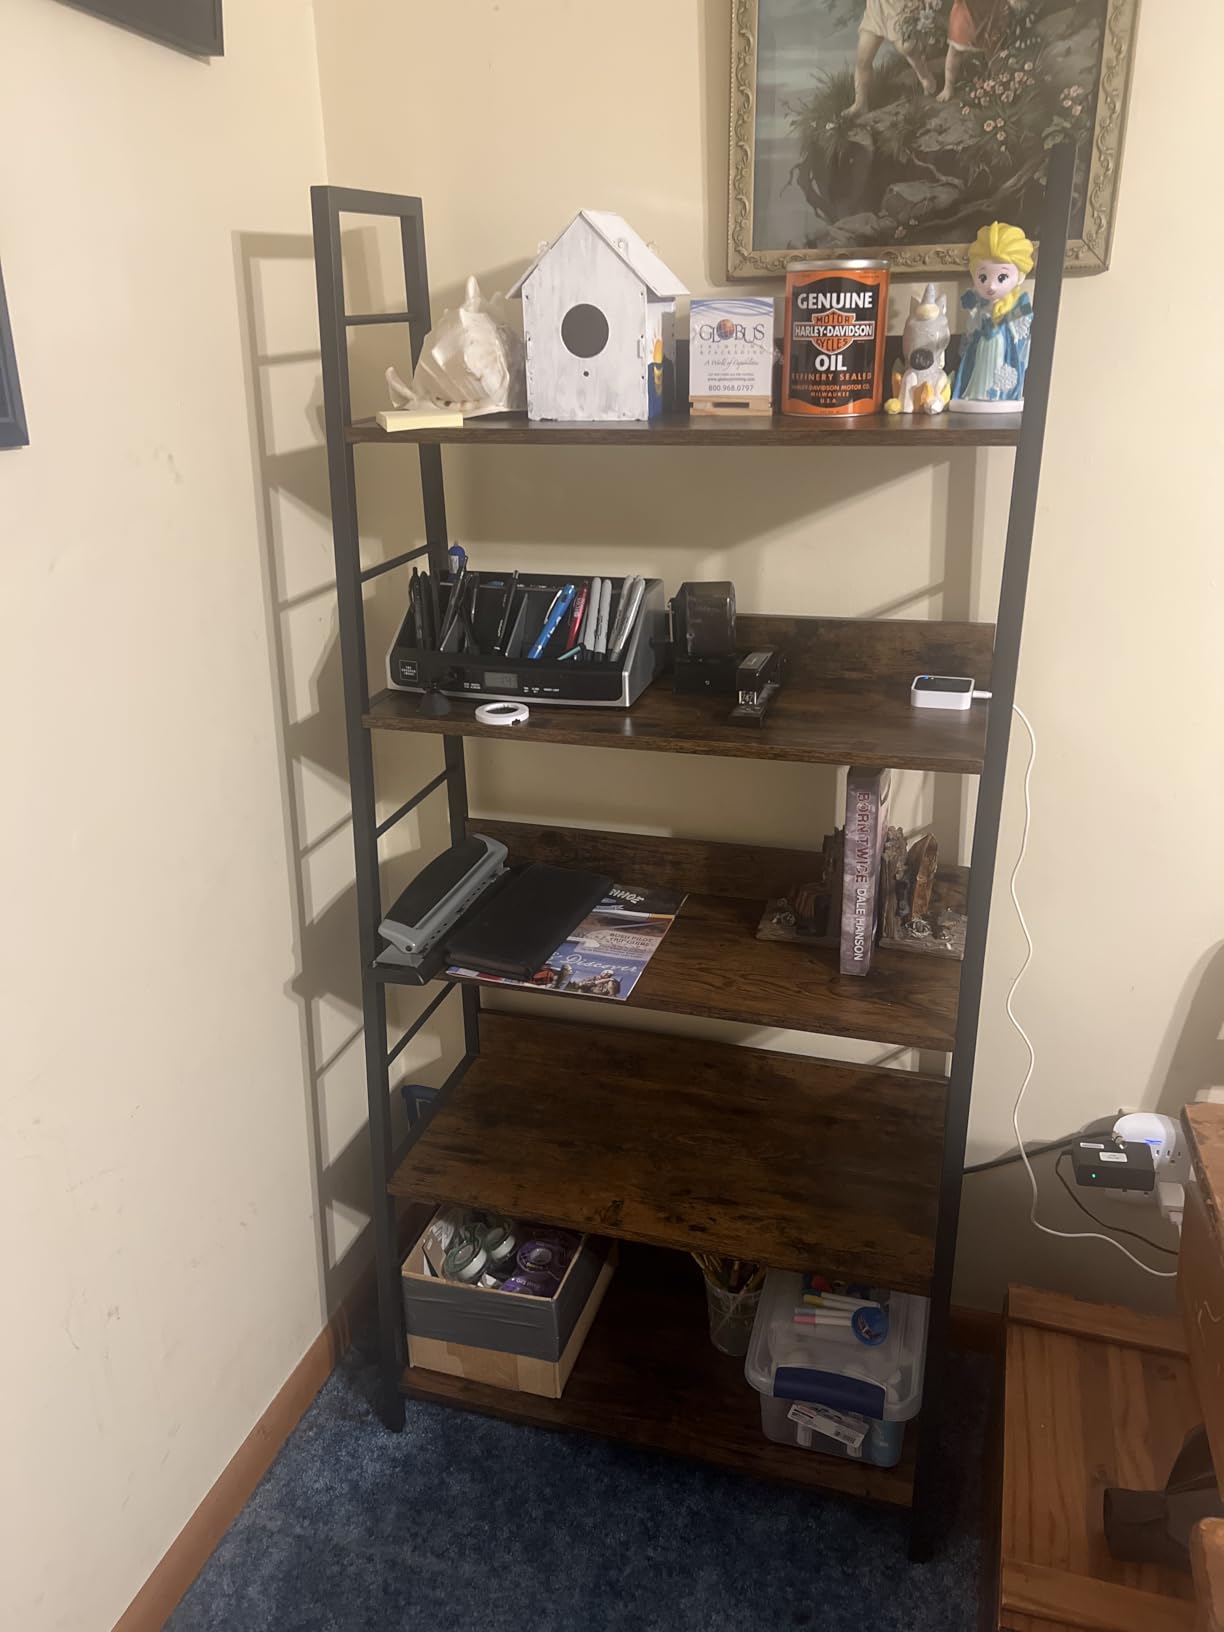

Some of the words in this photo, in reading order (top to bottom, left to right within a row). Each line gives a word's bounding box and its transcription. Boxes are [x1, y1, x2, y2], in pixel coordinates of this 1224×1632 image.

[797, 291, 873, 309] GENUINE
[816, 310, 850, 324] MOTOR
[795, 325, 872, 337] HARLEY-DAVIDSON
[815, 338, 849, 351] CYCLES
[814, 355, 848, 371] OIL
[792, 373, 833, 381] REFINERY
[840, 372, 872, 380] SEALED
[857, 792, 870, 833] BORN
[856, 837, 869, 883] TWICE
[856, 888, 867, 915] DALE
[854, 917, 866, 961] HANSON
[560, 953, 637, 972] Discover
